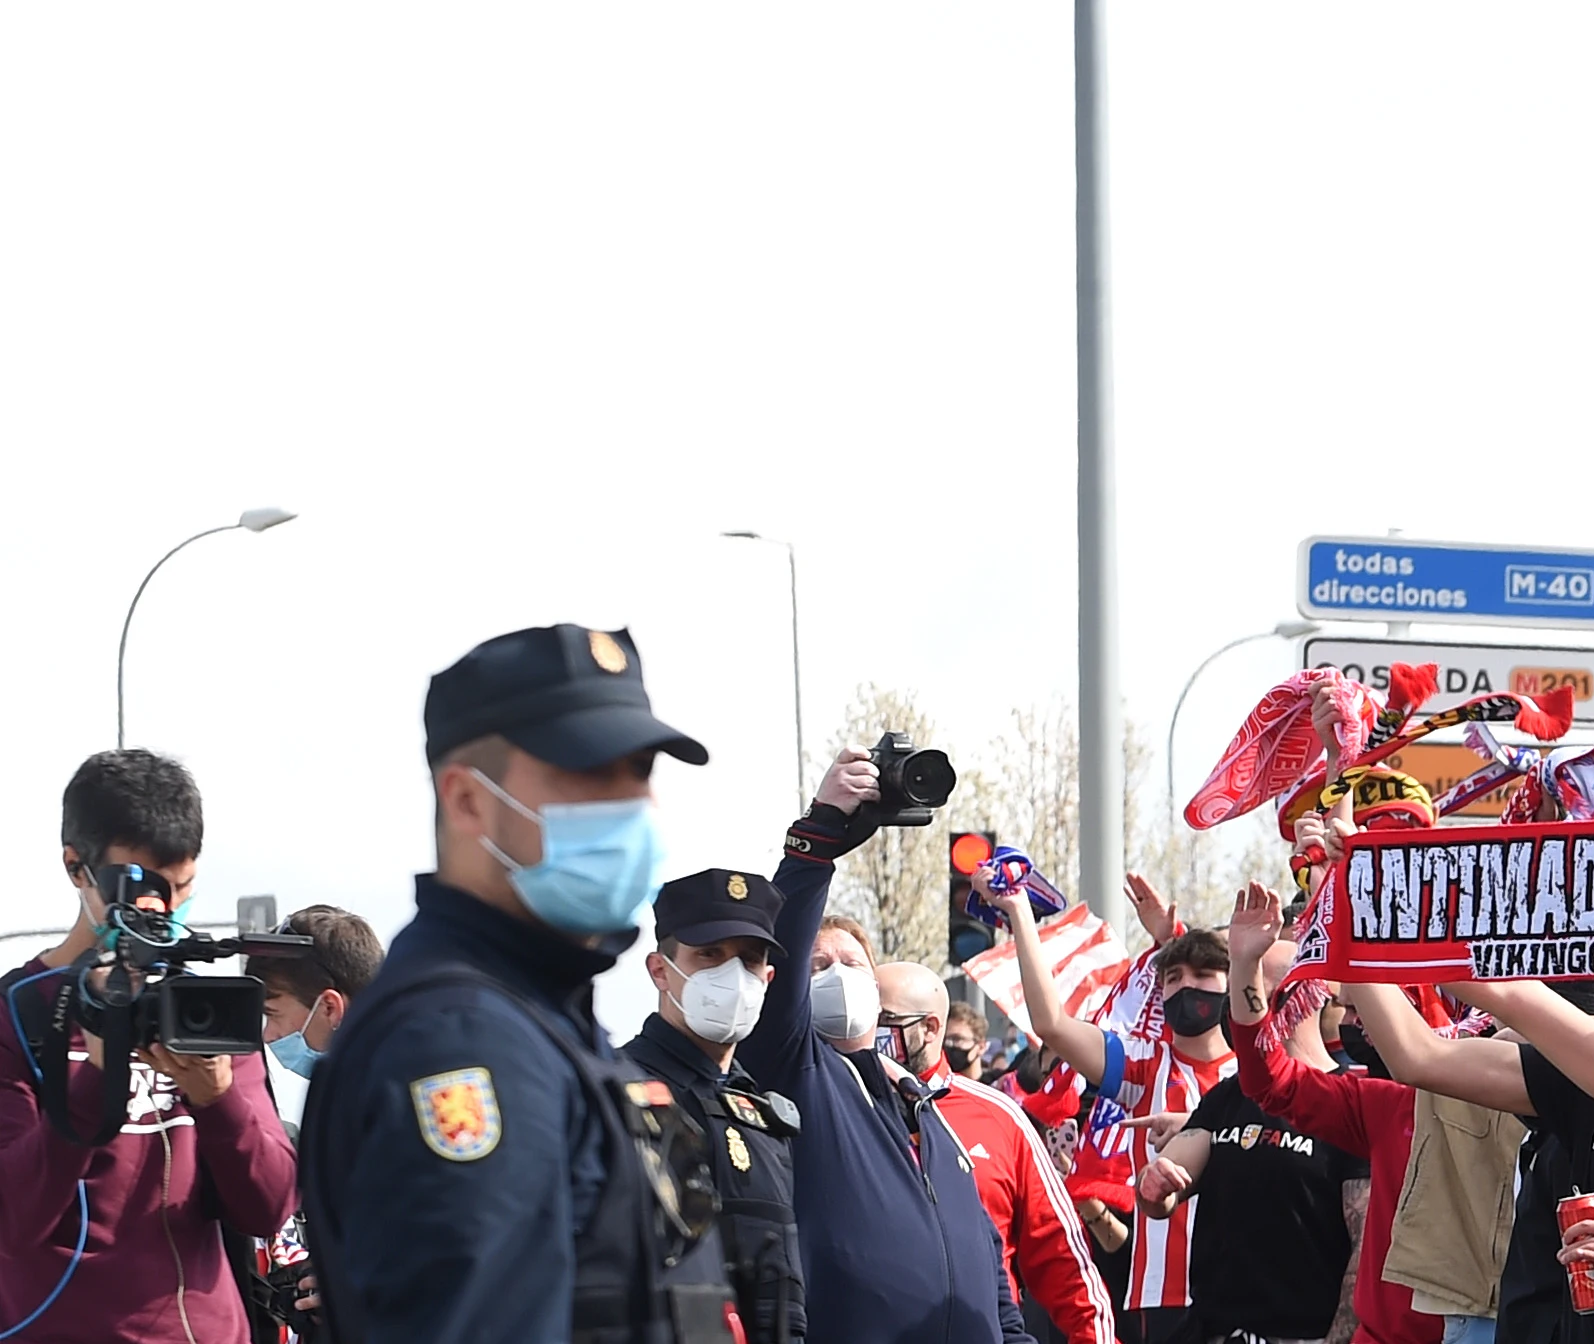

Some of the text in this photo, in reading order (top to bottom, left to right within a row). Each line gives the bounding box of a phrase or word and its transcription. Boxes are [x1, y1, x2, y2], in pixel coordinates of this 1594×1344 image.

[1335, 549, 1414, 577] todas
[1312, 578, 1468, 608] direcciones
[1511, 571, 1589, 599] M-40
[52, 985, 72, 1033] SONY
